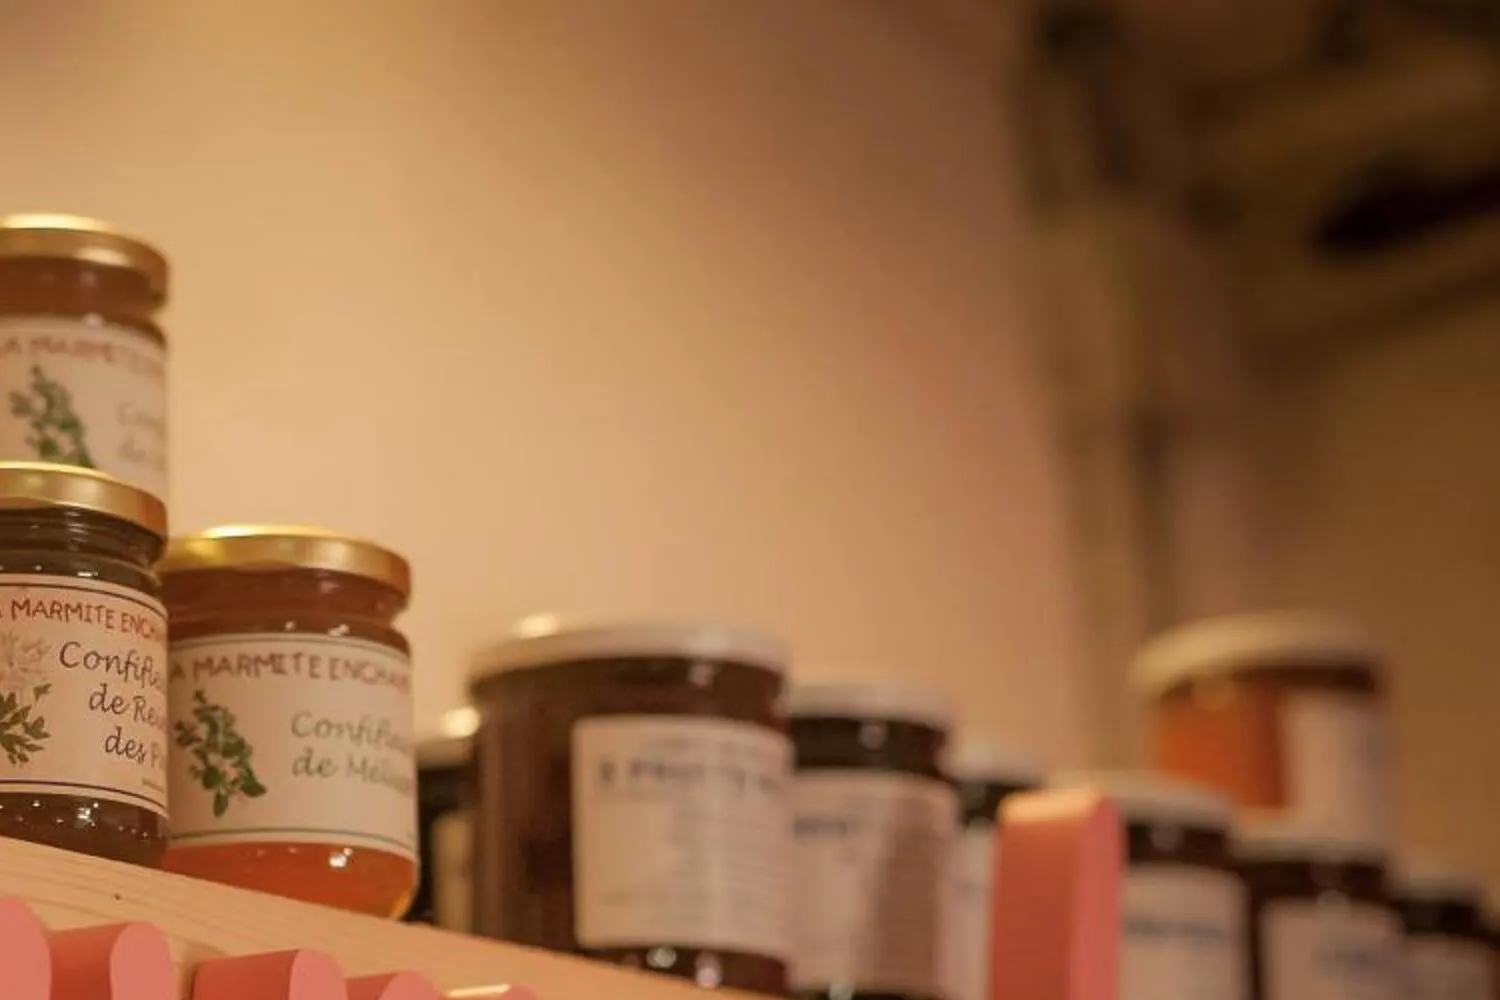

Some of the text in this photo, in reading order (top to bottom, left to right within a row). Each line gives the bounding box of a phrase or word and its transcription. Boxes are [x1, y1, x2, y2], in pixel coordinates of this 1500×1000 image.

[11, 599, 115, 630] MARMITE
[193, 652, 322, 681] MARMITE
[88, 683, 131, 715] de
[104, 726, 147, 765] des
[291, 746, 340, 778] de
